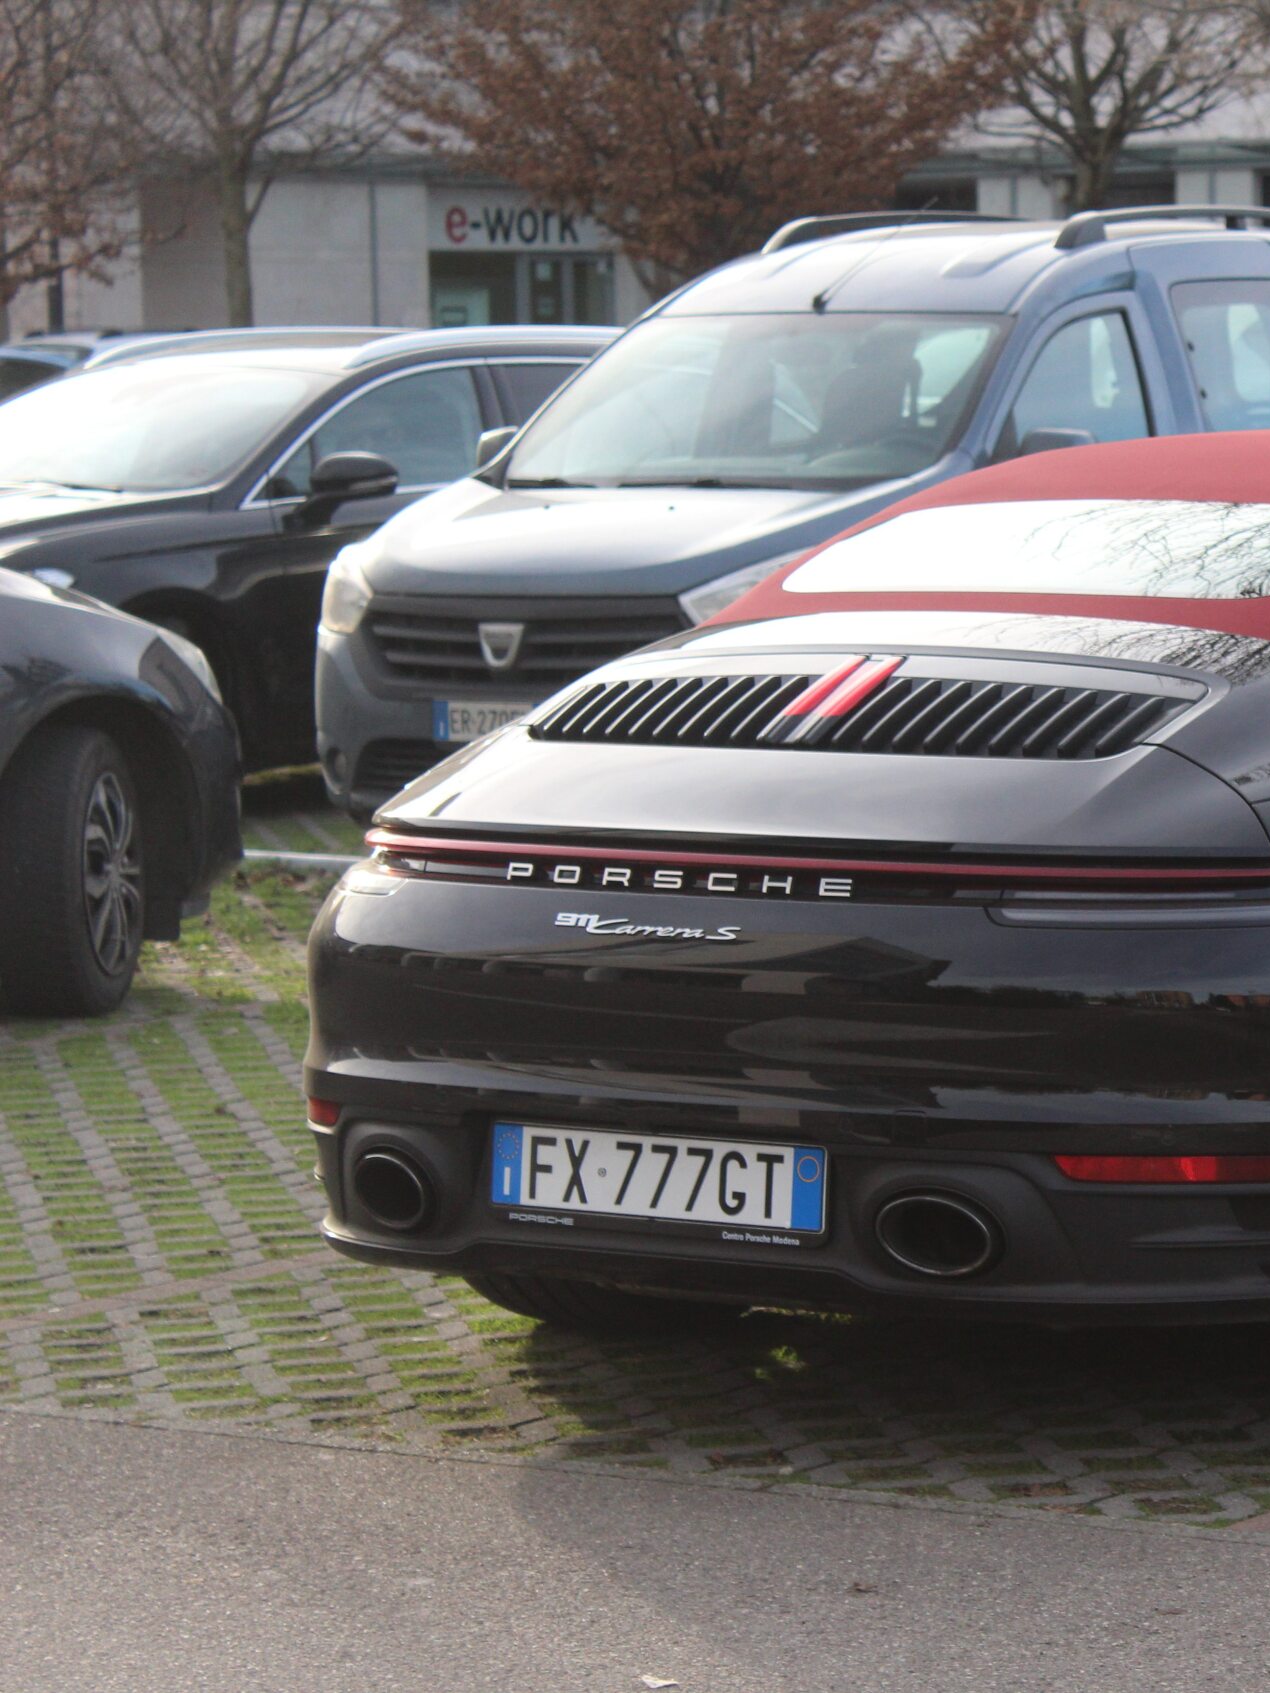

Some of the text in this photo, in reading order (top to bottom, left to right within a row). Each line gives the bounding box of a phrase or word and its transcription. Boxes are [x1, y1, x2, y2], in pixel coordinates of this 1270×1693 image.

[445, 206, 579, 244] e-work
[507, 862, 853, 897] PORSCHE
[554, 912, 742, 940] 911 Carrera S
[529, 1135, 785, 1219] FX 777GT
[509, 1212, 575, 1226] PORSCHE
[722, 1231, 800, 1246] Centro Porsche Modena
